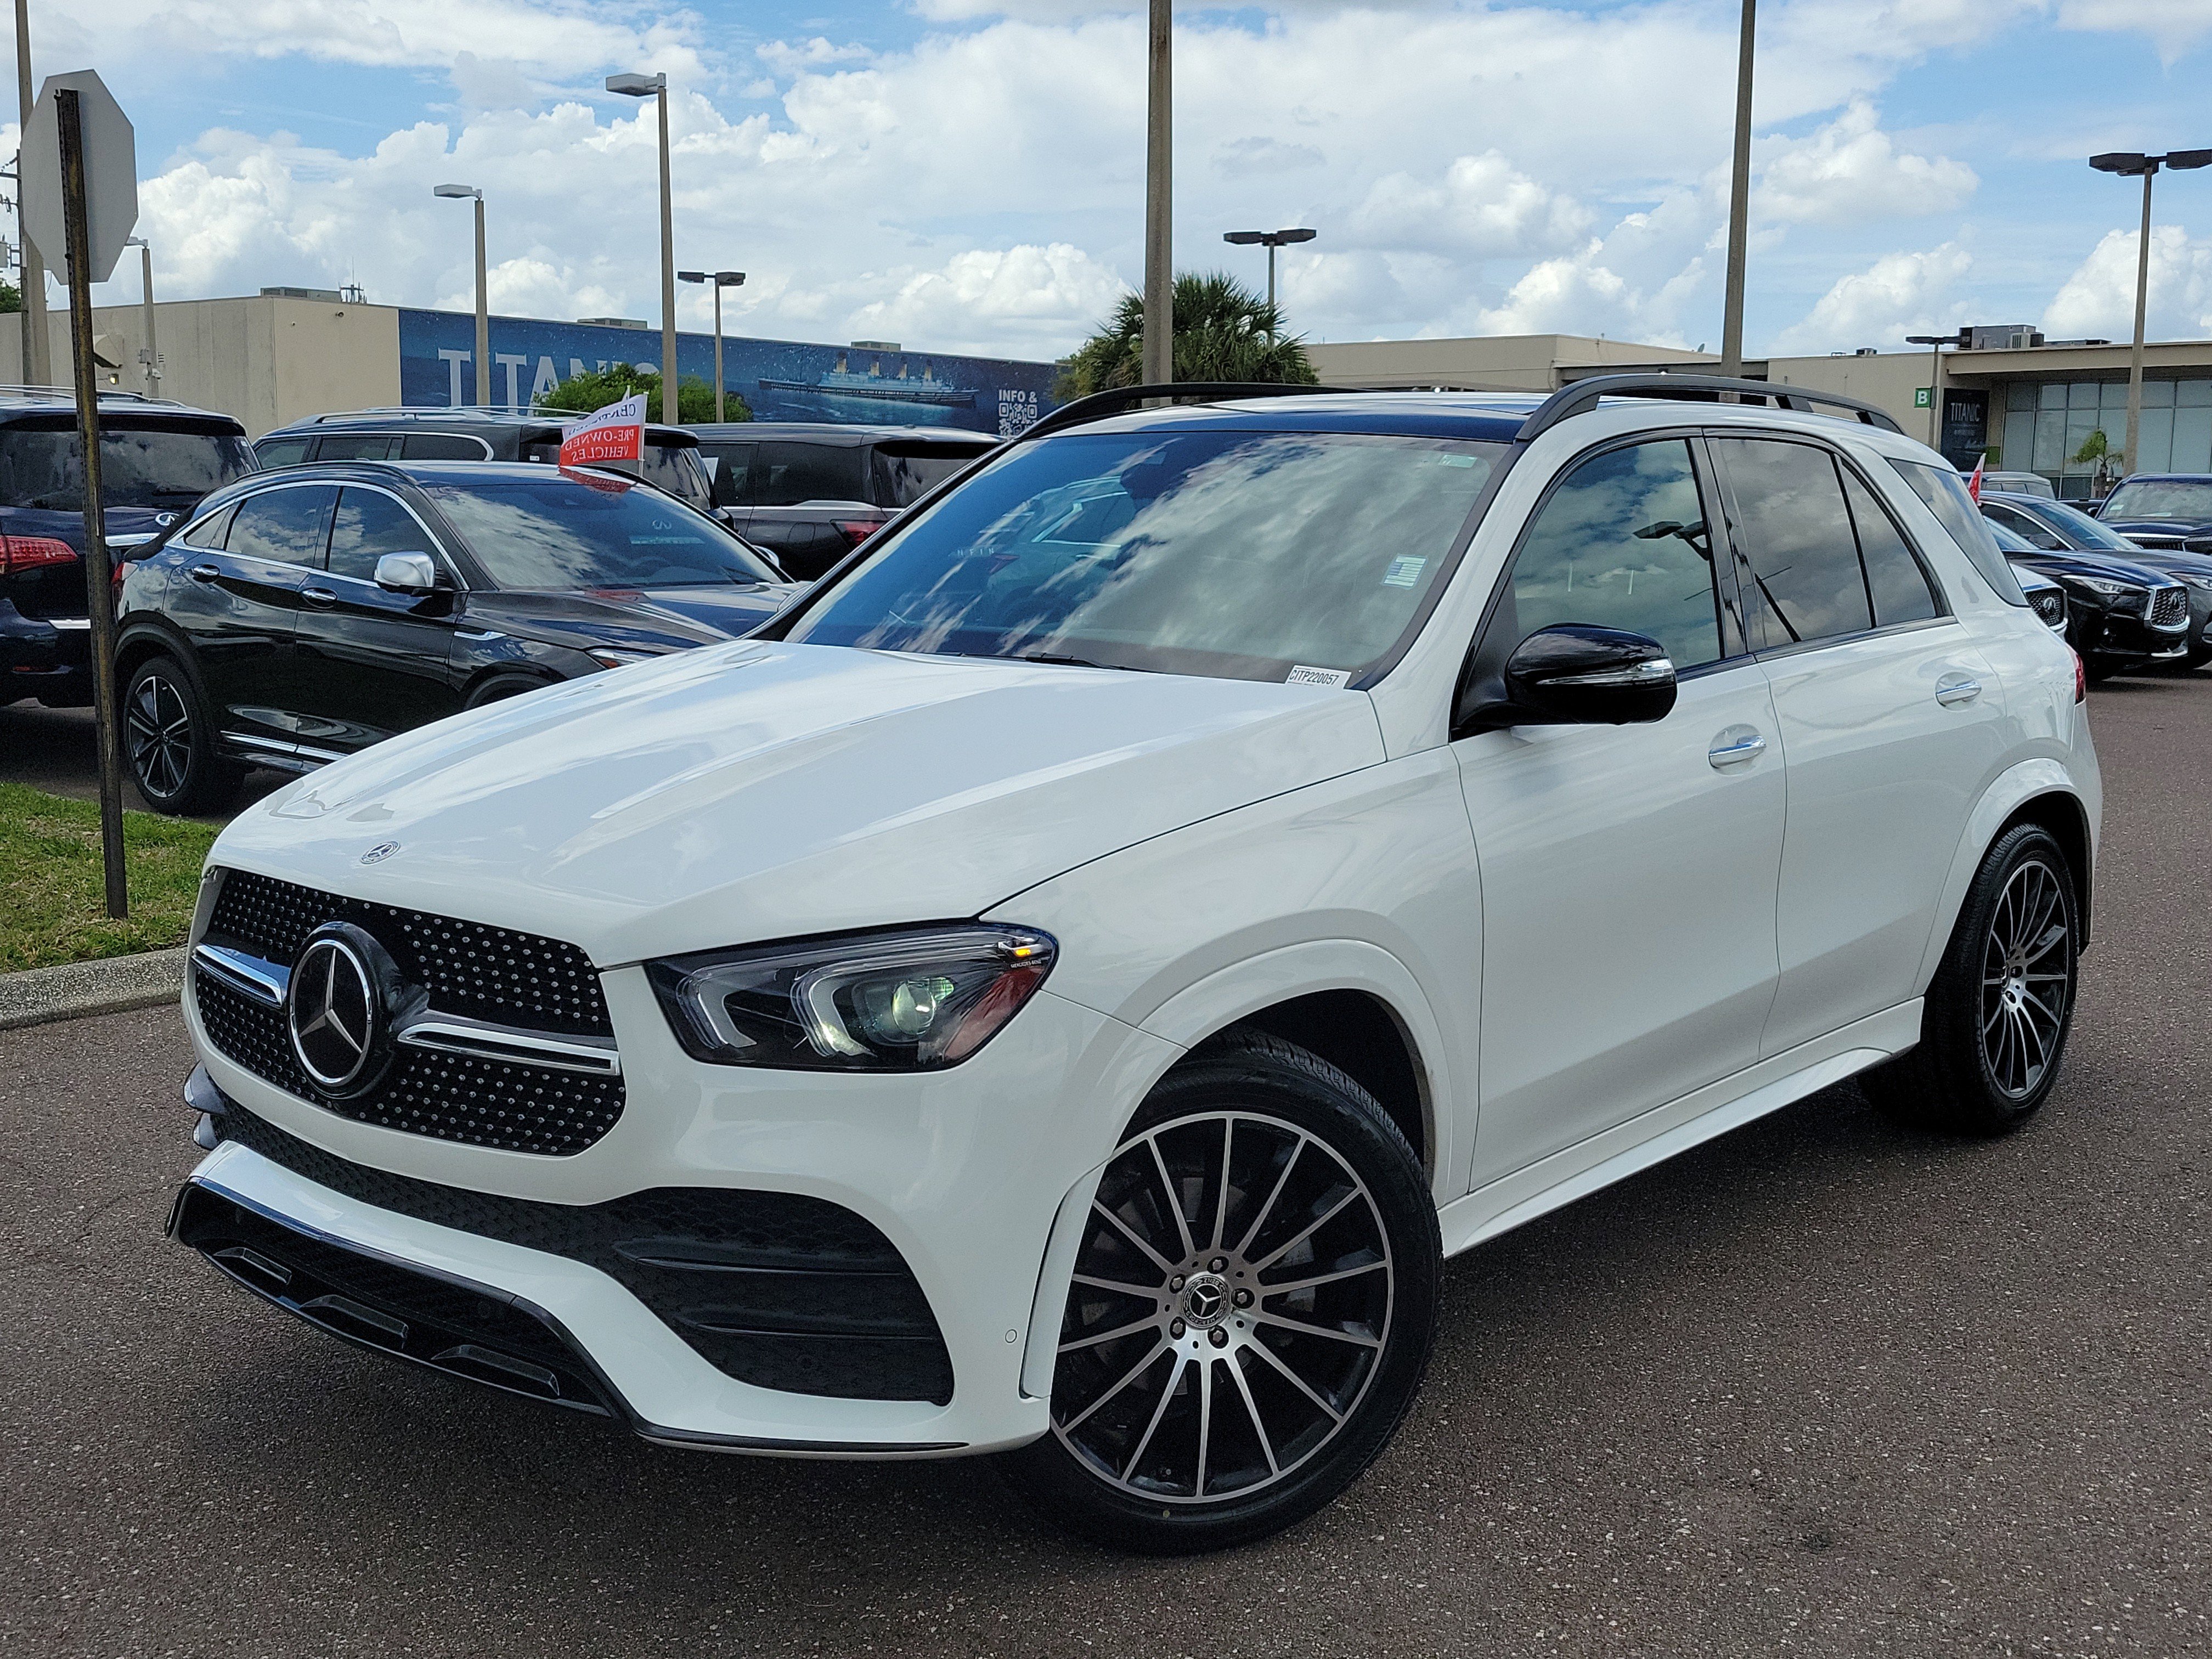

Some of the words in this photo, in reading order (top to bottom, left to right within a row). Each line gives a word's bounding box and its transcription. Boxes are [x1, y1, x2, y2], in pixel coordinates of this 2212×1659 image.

[998, 390, 1025, 402] INFO
[1029, 391, 1037, 403] &
[1917, 391, 1927, 404] B
